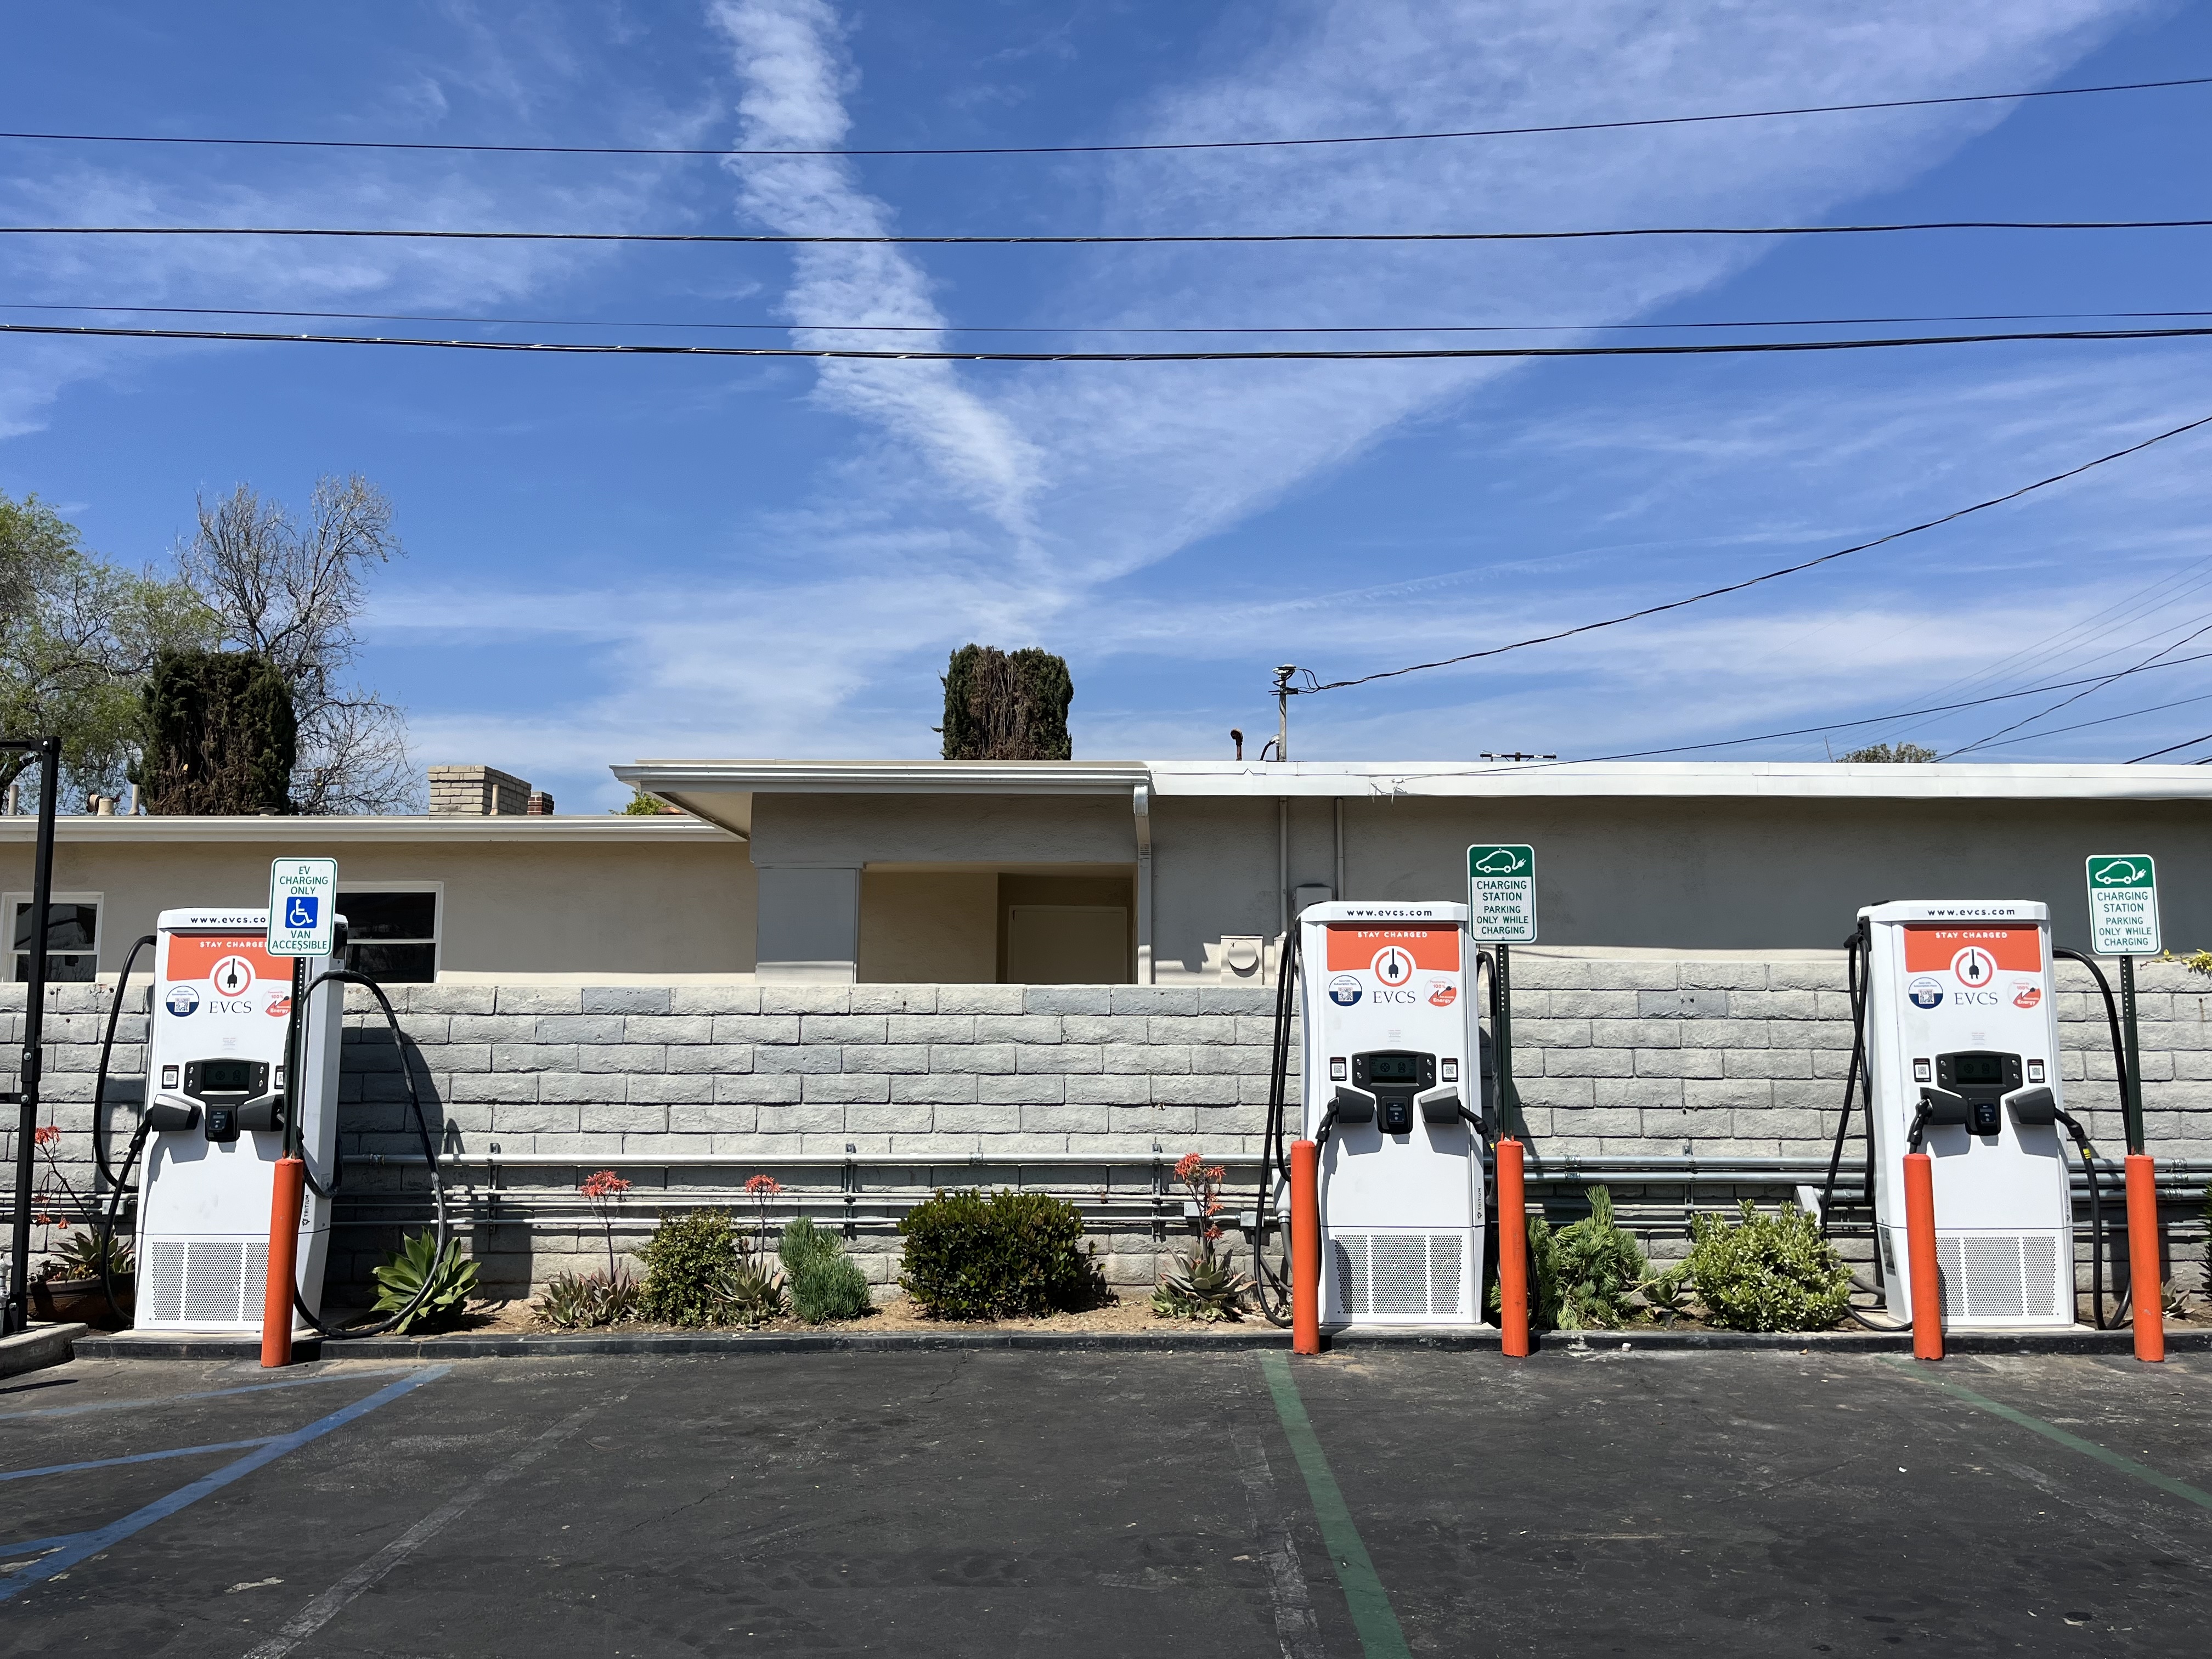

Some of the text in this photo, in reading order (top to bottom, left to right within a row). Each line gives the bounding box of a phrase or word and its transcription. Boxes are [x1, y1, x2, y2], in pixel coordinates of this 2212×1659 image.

[298, 866, 311, 874] EV
[279, 876, 328, 885] CHARGING
[1476, 881, 1527, 890] CHARGING
[290, 886, 316, 895] ONLY
[1482, 892, 1522, 901] STATION
[2097, 891, 2148, 901] CHARGING
[2103, 903, 2144, 912] STATION
[1476, 916, 1529, 924] ONLY WHILE
[2106, 917, 2143, 925] PARKING
[291, 930, 311, 939] VAN
[1481, 926, 1525, 934] CHARGING
[2099, 927, 2152, 936] ONLY WHILE
[272, 940, 328, 949] ACCESSIBLE
[2104, 938, 2148, 946] CHARGING
[1373, 991, 1416, 1003] EVCS
[1954, 992, 1998, 1005] EVCS
[208, 1001, 252, 1014] EVCS
